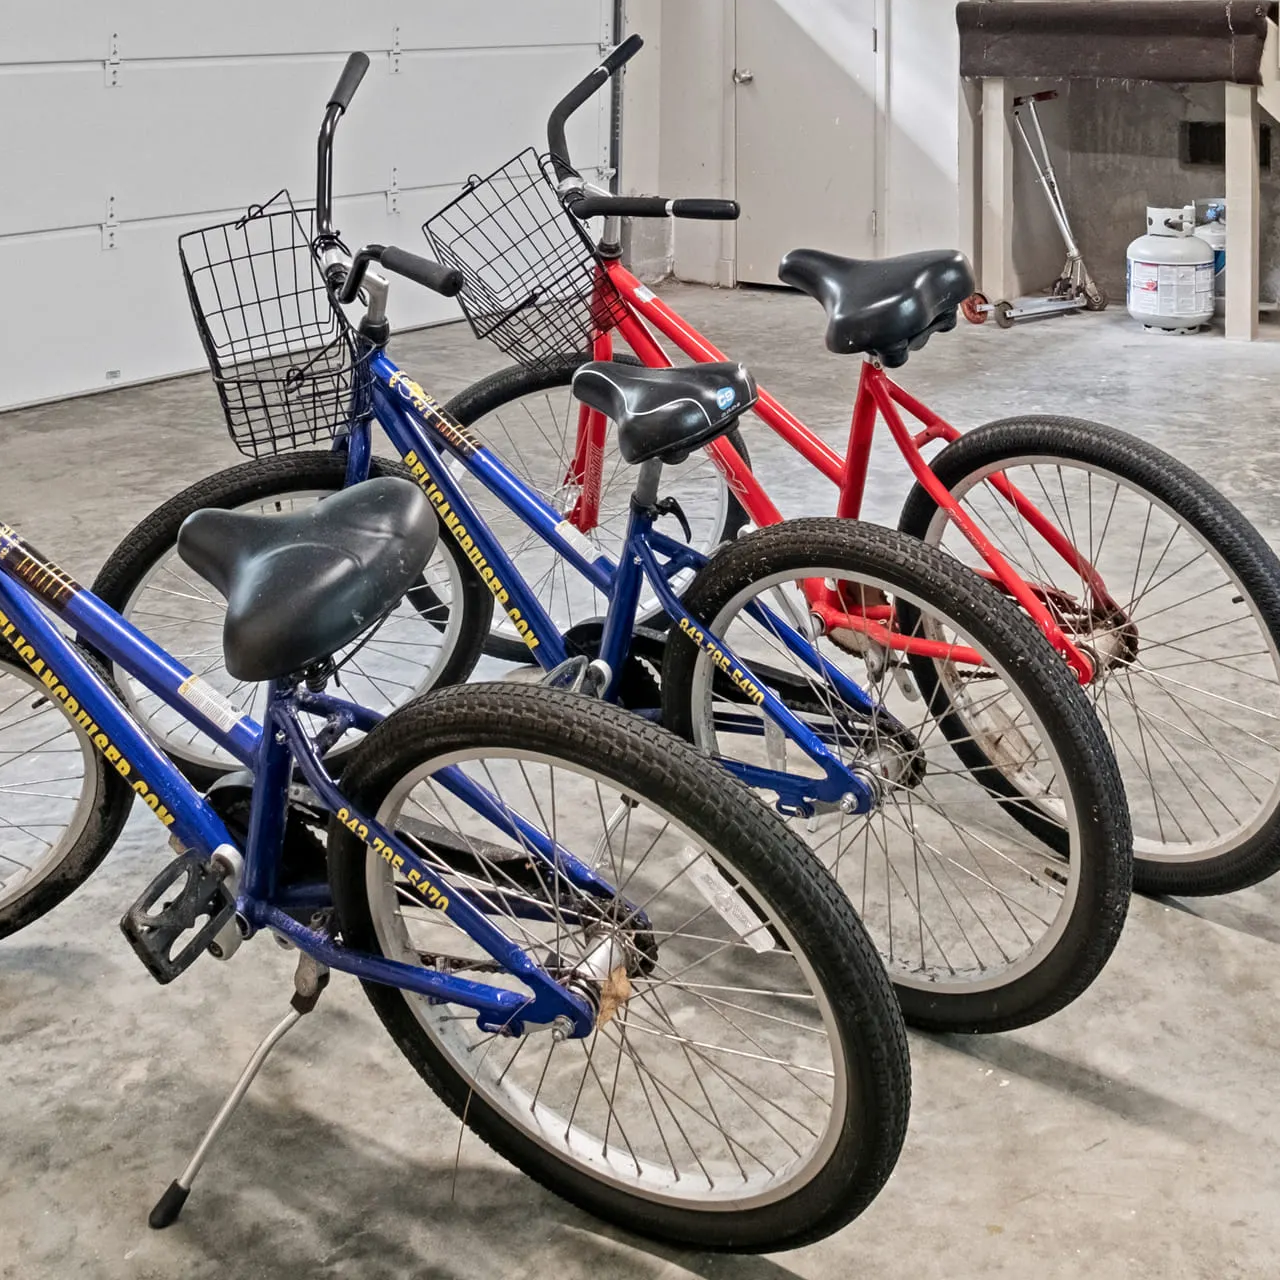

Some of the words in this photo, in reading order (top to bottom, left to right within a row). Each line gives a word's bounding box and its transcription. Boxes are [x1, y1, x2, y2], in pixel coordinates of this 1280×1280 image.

[403, 450, 540, 649] PELICANCRUISERCOM
[678, 617, 766, 706] 8437855470
[336, 806, 450, 913] 8437855470
